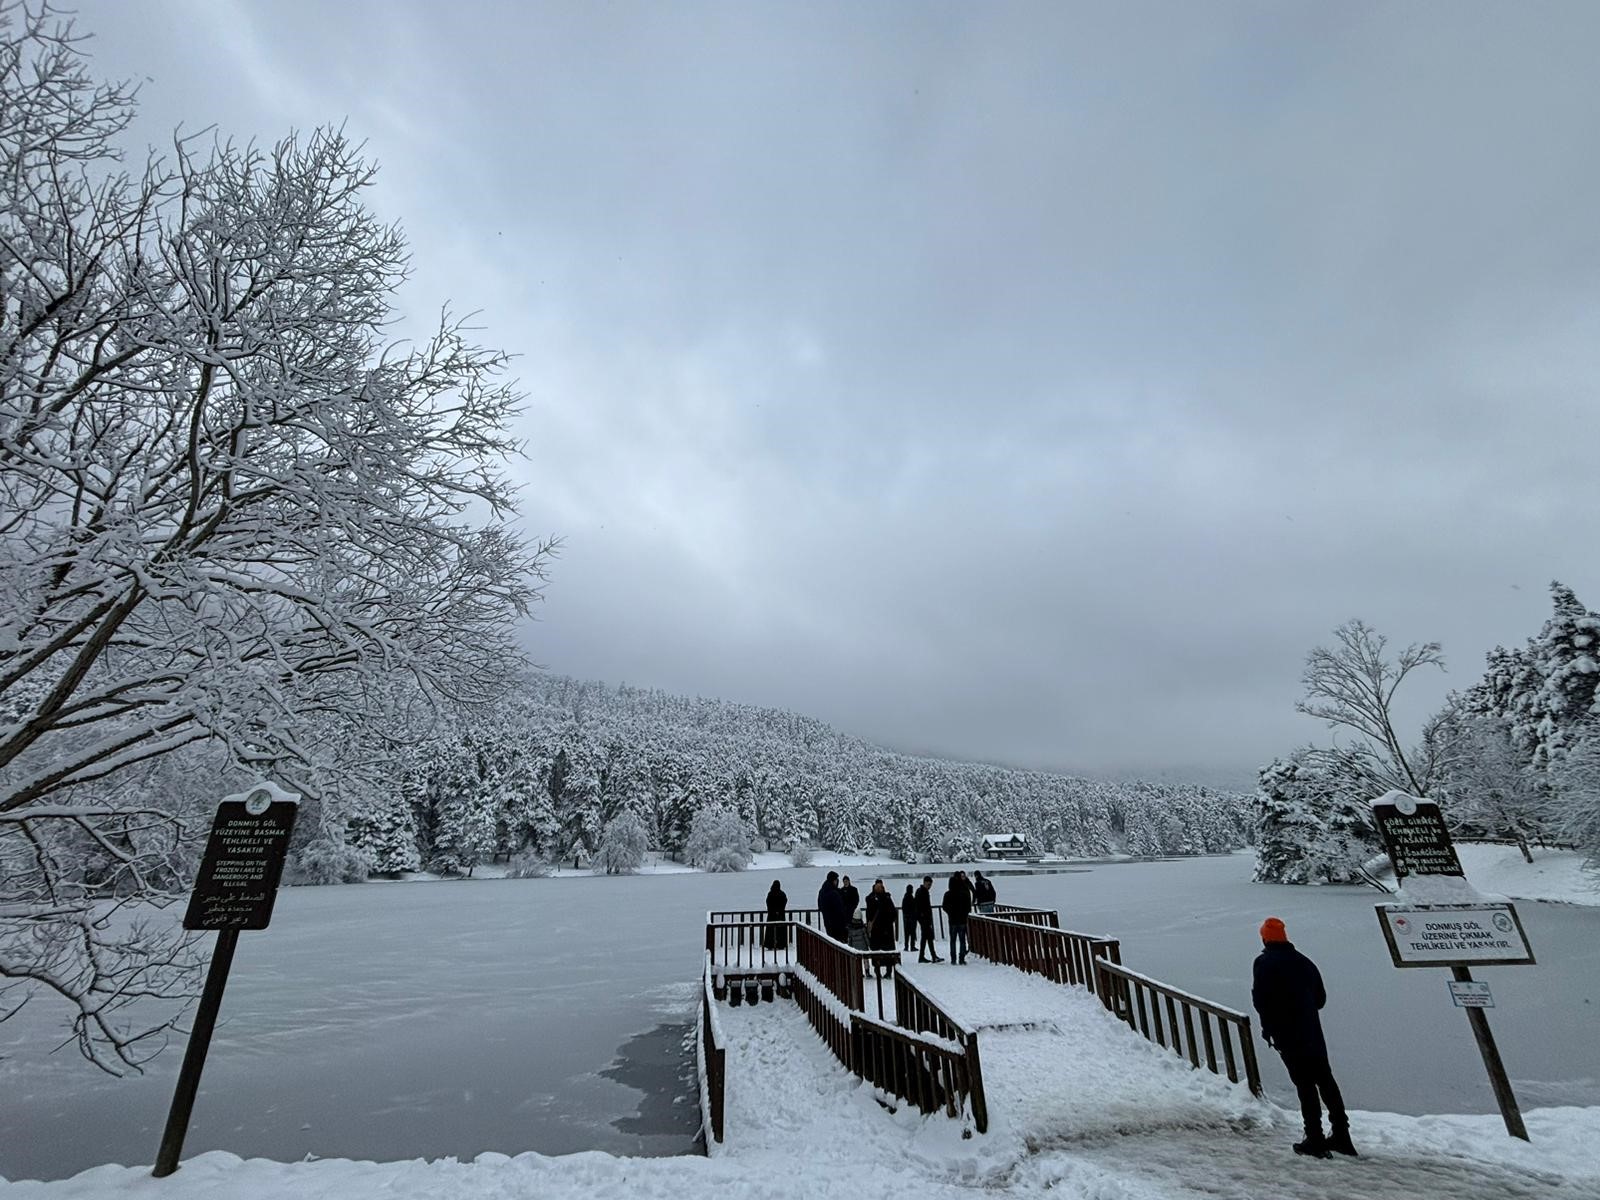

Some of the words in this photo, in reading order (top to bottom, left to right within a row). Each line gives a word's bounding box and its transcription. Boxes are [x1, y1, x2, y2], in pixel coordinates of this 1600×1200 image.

[263, 819, 277, 827] GÖL
[254, 828, 286, 836] BASMAK
[227, 846, 264, 854] YASAKTIR
[1425, 923, 1462, 931] DONMUŞ
[1463, 921, 1482, 929] GÖL
[1421, 932, 1458, 940] ÜZERİNE
[1459, 931, 1493, 941] ÇIKMAK
[1410, 942, 1454, 950] TEHLİKELİ
